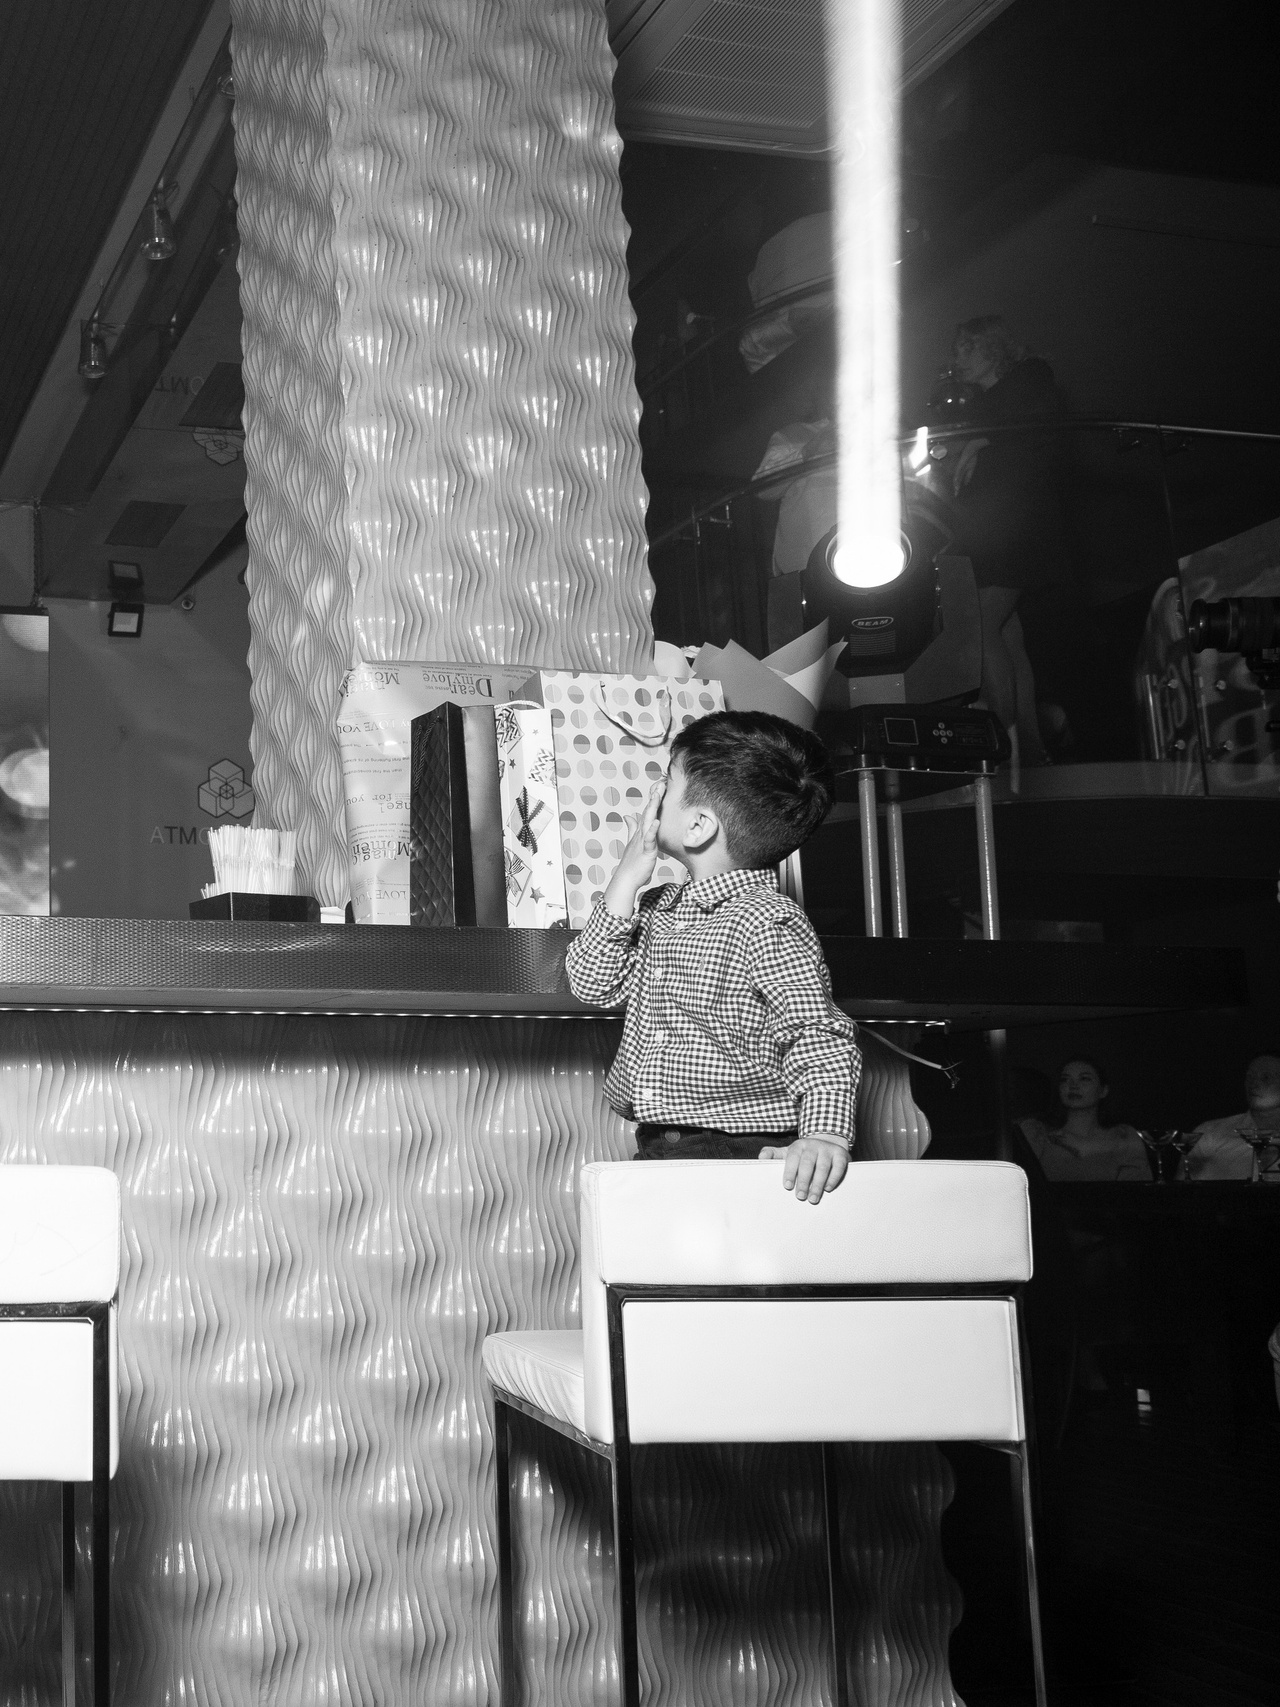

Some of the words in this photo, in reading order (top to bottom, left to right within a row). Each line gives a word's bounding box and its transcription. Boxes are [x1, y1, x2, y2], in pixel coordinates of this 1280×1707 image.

[857, 619, 889, 627] BEAM
[450, 677, 494, 699] Dear
[346, 792, 365, 807] you
[371, 793, 392, 804] for
[378, 800, 411, 813] ngel
[351, 840, 410, 857] Momen
[375, 889, 407, 900] LOVE
